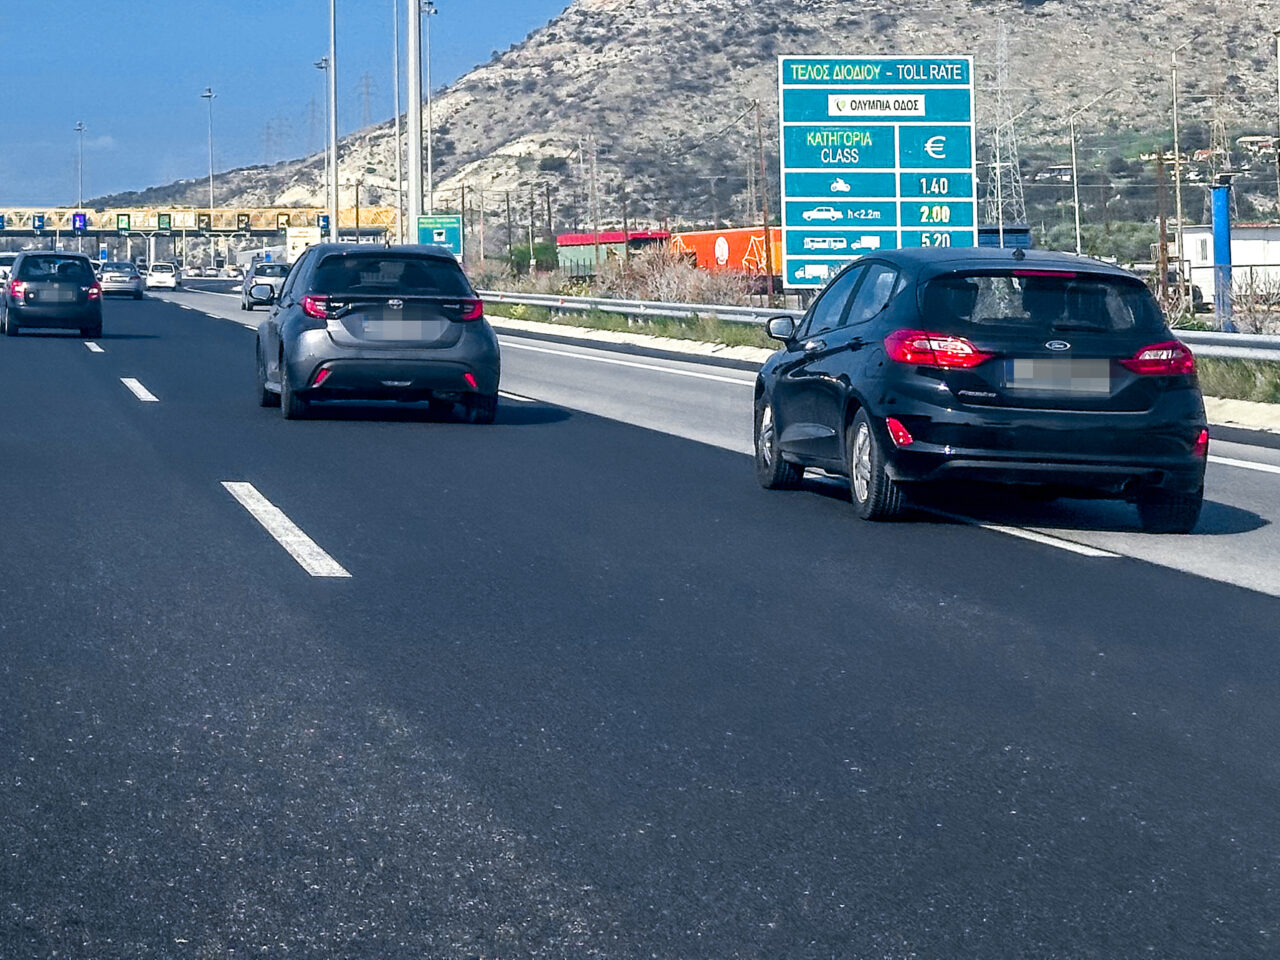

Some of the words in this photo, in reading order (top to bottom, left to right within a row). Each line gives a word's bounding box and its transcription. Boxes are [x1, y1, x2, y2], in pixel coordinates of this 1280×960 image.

[790, 64, 830, 80] ΤΕΛΟΣ
[832, 64, 882, 80] ΔΙΟΔΙΟΥ
[896, 64, 928, 80] TOLL
[929, 64, 962, 80] RATE
[850, 99, 892, 111] ΟΛΥΜΠΙΑ
[893, 99, 919, 111] ΟΔΟΣ
[806, 131, 873, 146] ΚΑΤΗΓΟΡΙΑ
[820, 148, 859, 163] CLASS
[919, 177, 948, 194] 1.40
[920, 205, 951, 223] 2.00
[921, 233, 951, 248] 520
